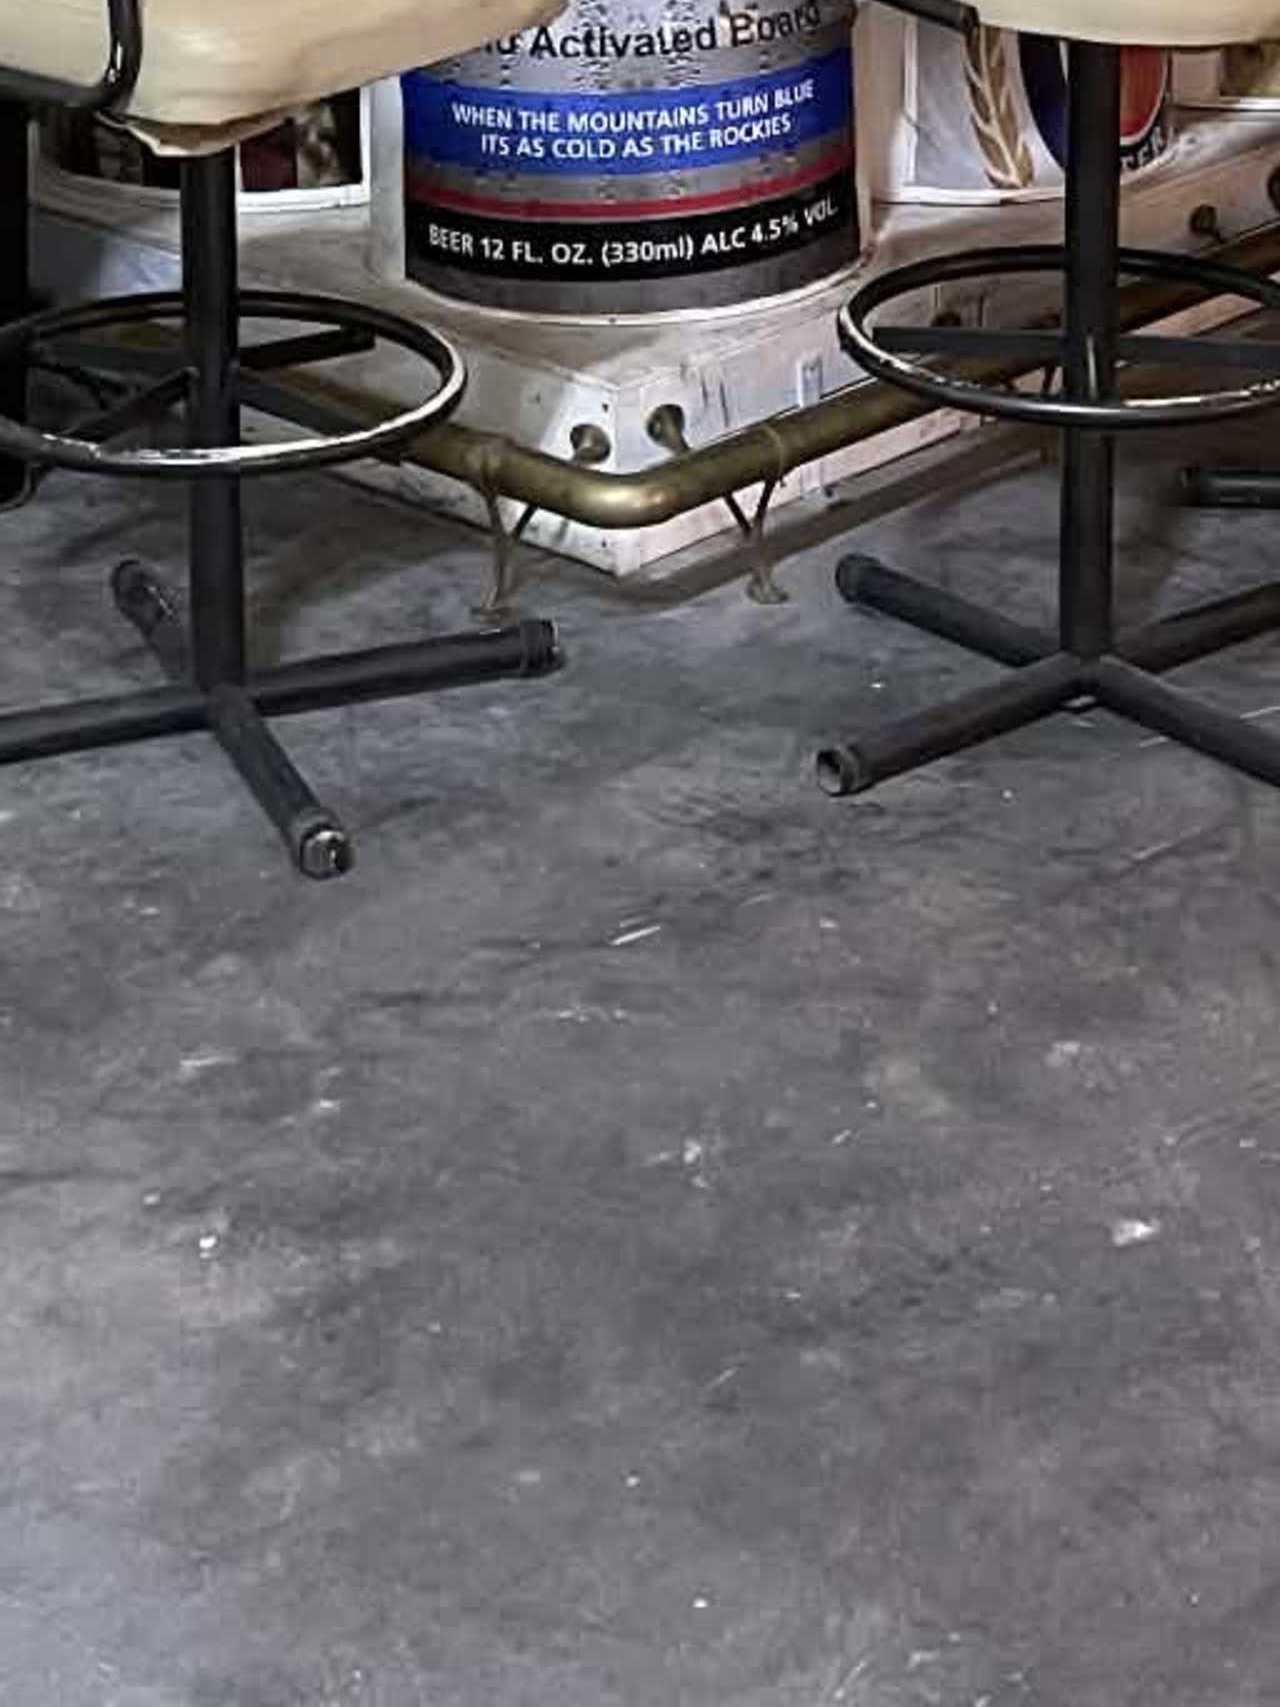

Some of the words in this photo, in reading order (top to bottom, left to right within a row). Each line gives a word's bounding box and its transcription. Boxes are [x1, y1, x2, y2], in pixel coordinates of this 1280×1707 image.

[529, 17, 718, 58] Activated
[452, 101, 512, 130] WHEN
[521, 110, 561, 132] THE
[569, 105, 710, 133] MOUNTAINS
[716, 92, 769, 120] TURN
[774, 78, 816, 109] BLUE
[480, 133, 510, 156] ITS
[516, 136, 544, 156] AS
[552, 137, 616, 159] COLD
[622, 136, 654, 158] AS
[660, 131, 705, 155] THE
[710, 113, 792, 148] ROCKIES
[428, 222, 473, 258] BEER
[479, 237, 505, 260] 12
[511, 240, 544, 264] FL.
[551, 242, 594, 265] OZ.
[601, 233, 694, 268] (330ml)
[701, 226, 746, 255] ALC
[751, 212, 799, 243] 4.5%
